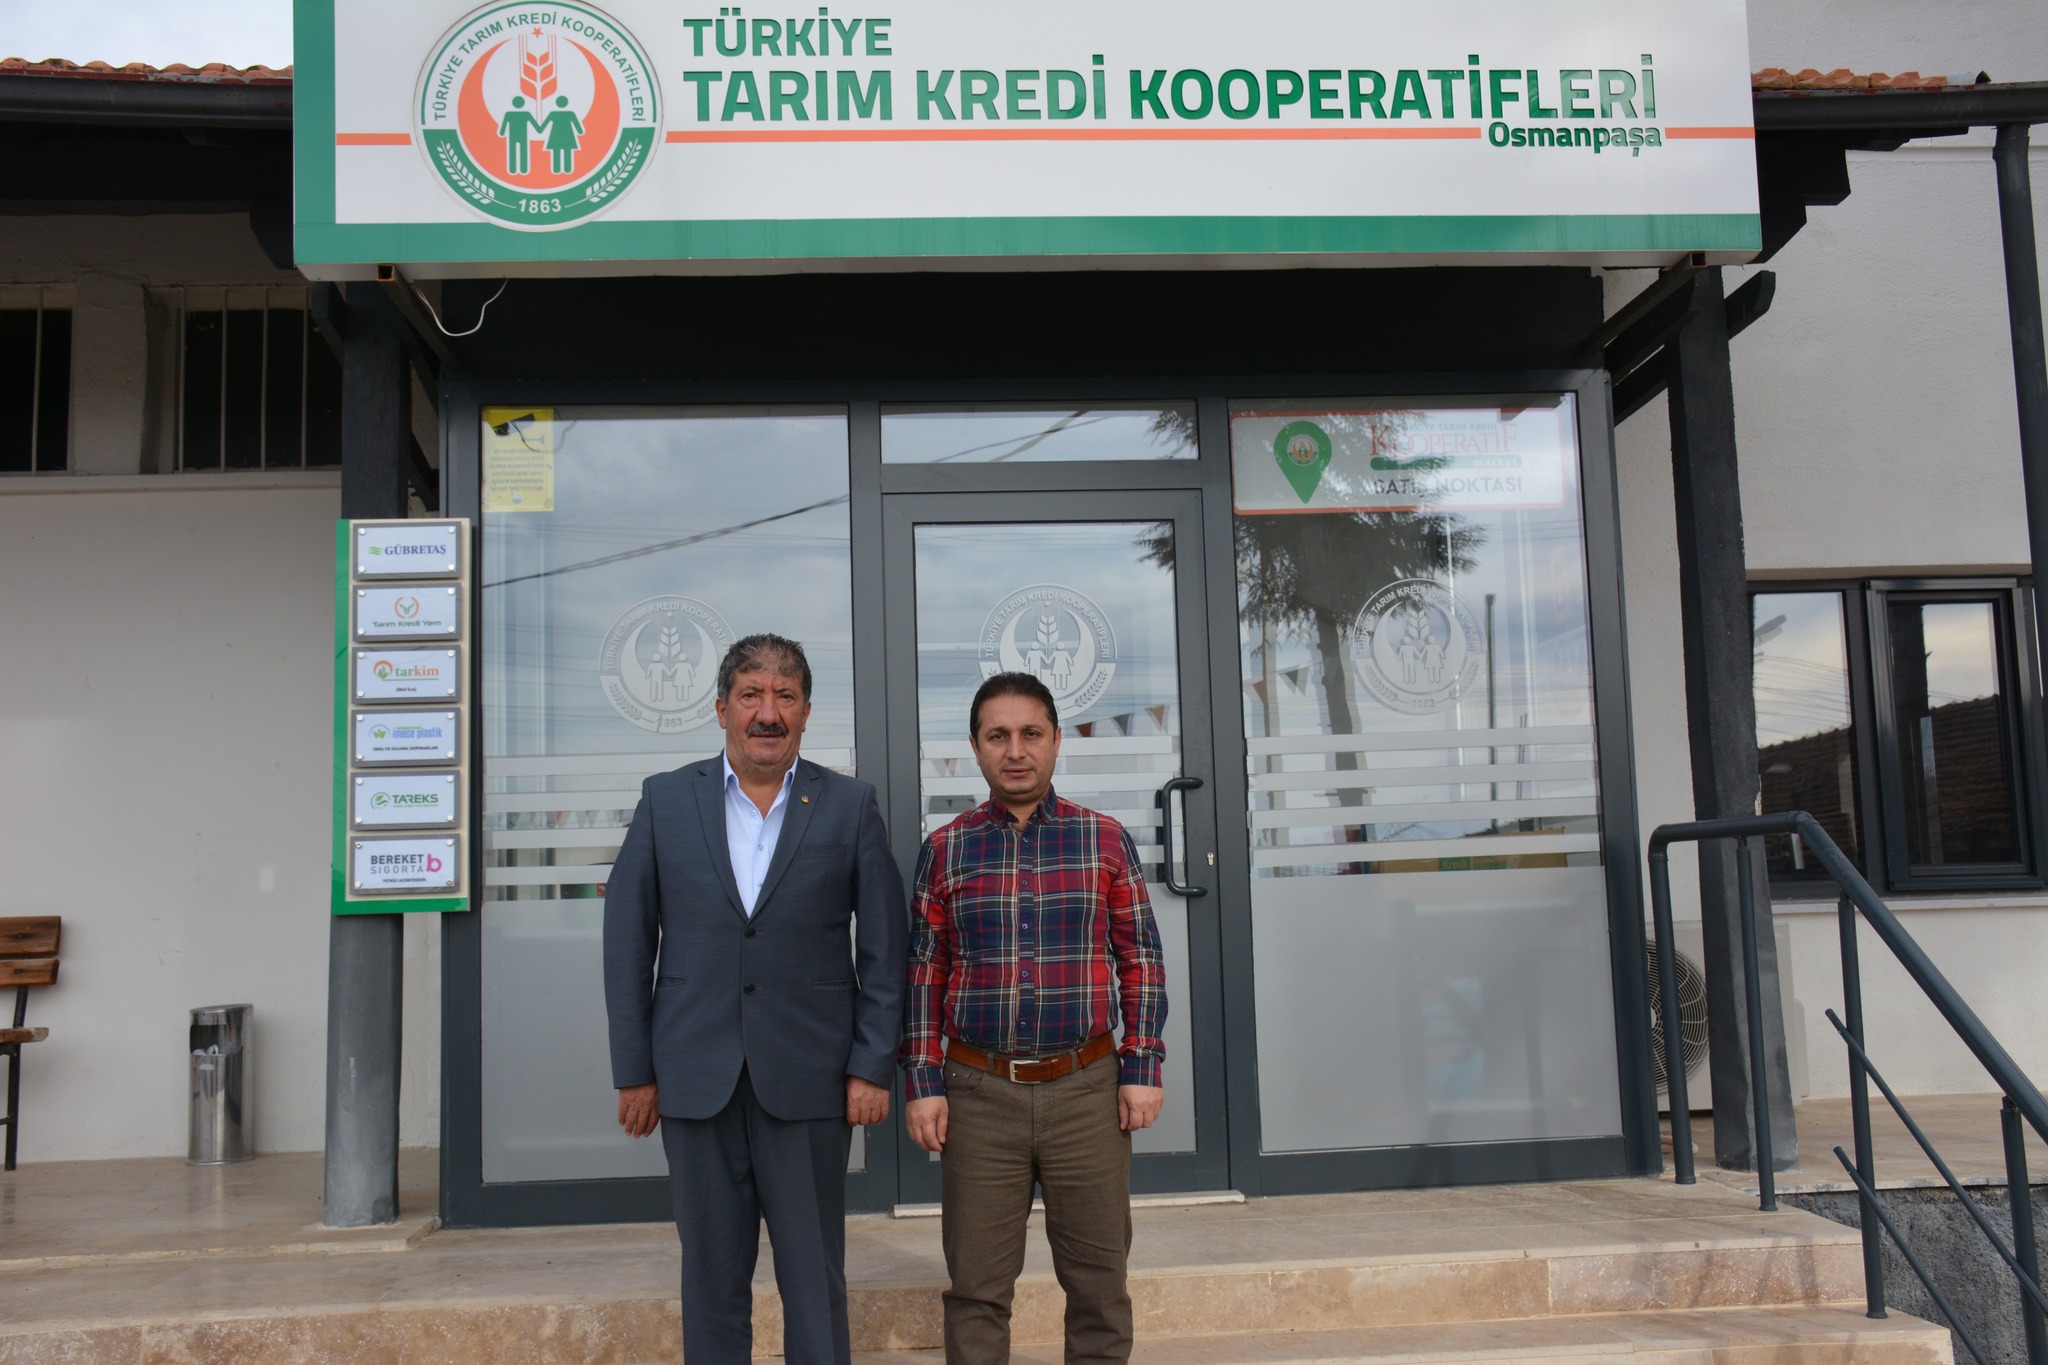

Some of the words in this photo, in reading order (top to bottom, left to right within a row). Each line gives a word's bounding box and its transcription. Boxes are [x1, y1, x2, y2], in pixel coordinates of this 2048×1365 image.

[683, 7, 892, 56] TÜRKİYE
[432, 55, 463, 121] TÜRKİYE
[459, 20, 504, 55] TARIM
[506, 11, 557, 28] KREDİ
[561, 16, 646, 122] KOOPERATİFLERİ
[683, 70, 893, 122] TARIM
[916, 54, 1107, 120] KREDİ
[1129, 54, 1657, 120] KOOPERATİFLERİ
[1488, 121, 1663, 157] Osmanpaşa
[518, 198, 562, 214] 1863
[1439, 423, 1468, 432] TARIM
[1473, 457, 1518, 468] market
[1435, 476, 1522, 494] NOKTASI
[384, 544, 446, 556] GÜBRETAŞ
[649, 601, 680, 612] KREDİ
[1000, 596, 1027, 618] TARIM
[1028, 590, 1058, 603] KREDİ
[1371, 592, 1397, 614] TARIM
[1398, 585, 1424, 597] KRED
[395, 665, 439, 677] tarkim
[417, 727, 443, 739] plastik
[392, 793, 439, 804] TAREKS
[371, 854, 424, 865] BEREKET
